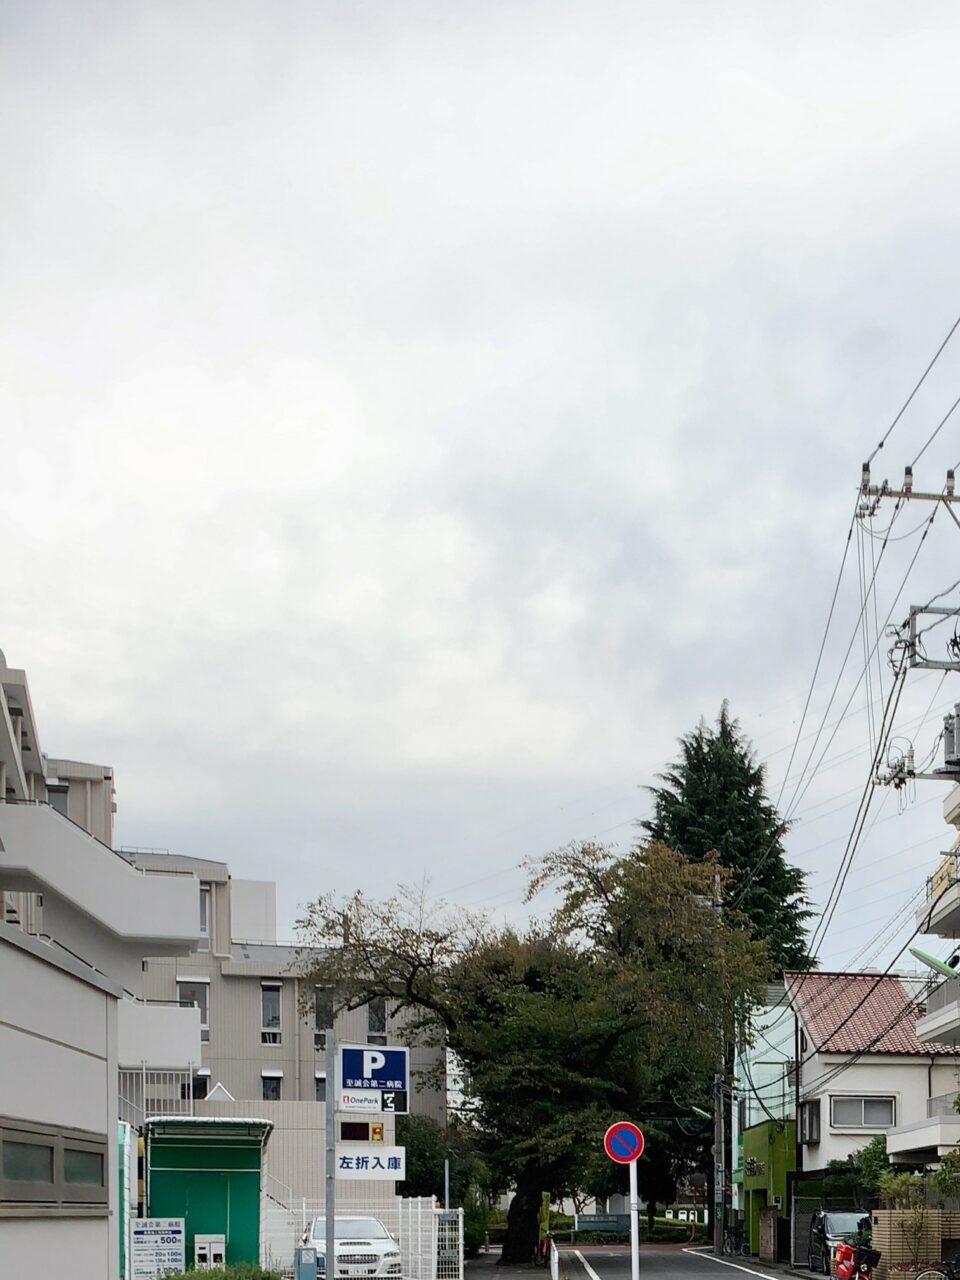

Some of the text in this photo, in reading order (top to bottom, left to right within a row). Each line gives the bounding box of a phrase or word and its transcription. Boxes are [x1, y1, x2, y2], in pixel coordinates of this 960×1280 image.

[363, 1050, 386, 1079] P
[346, 1079, 403, 1088] 至誠会第二病院
[350, 1096, 379, 1105] OnePark
[339, 1156, 402, 1170] 左折入庫
